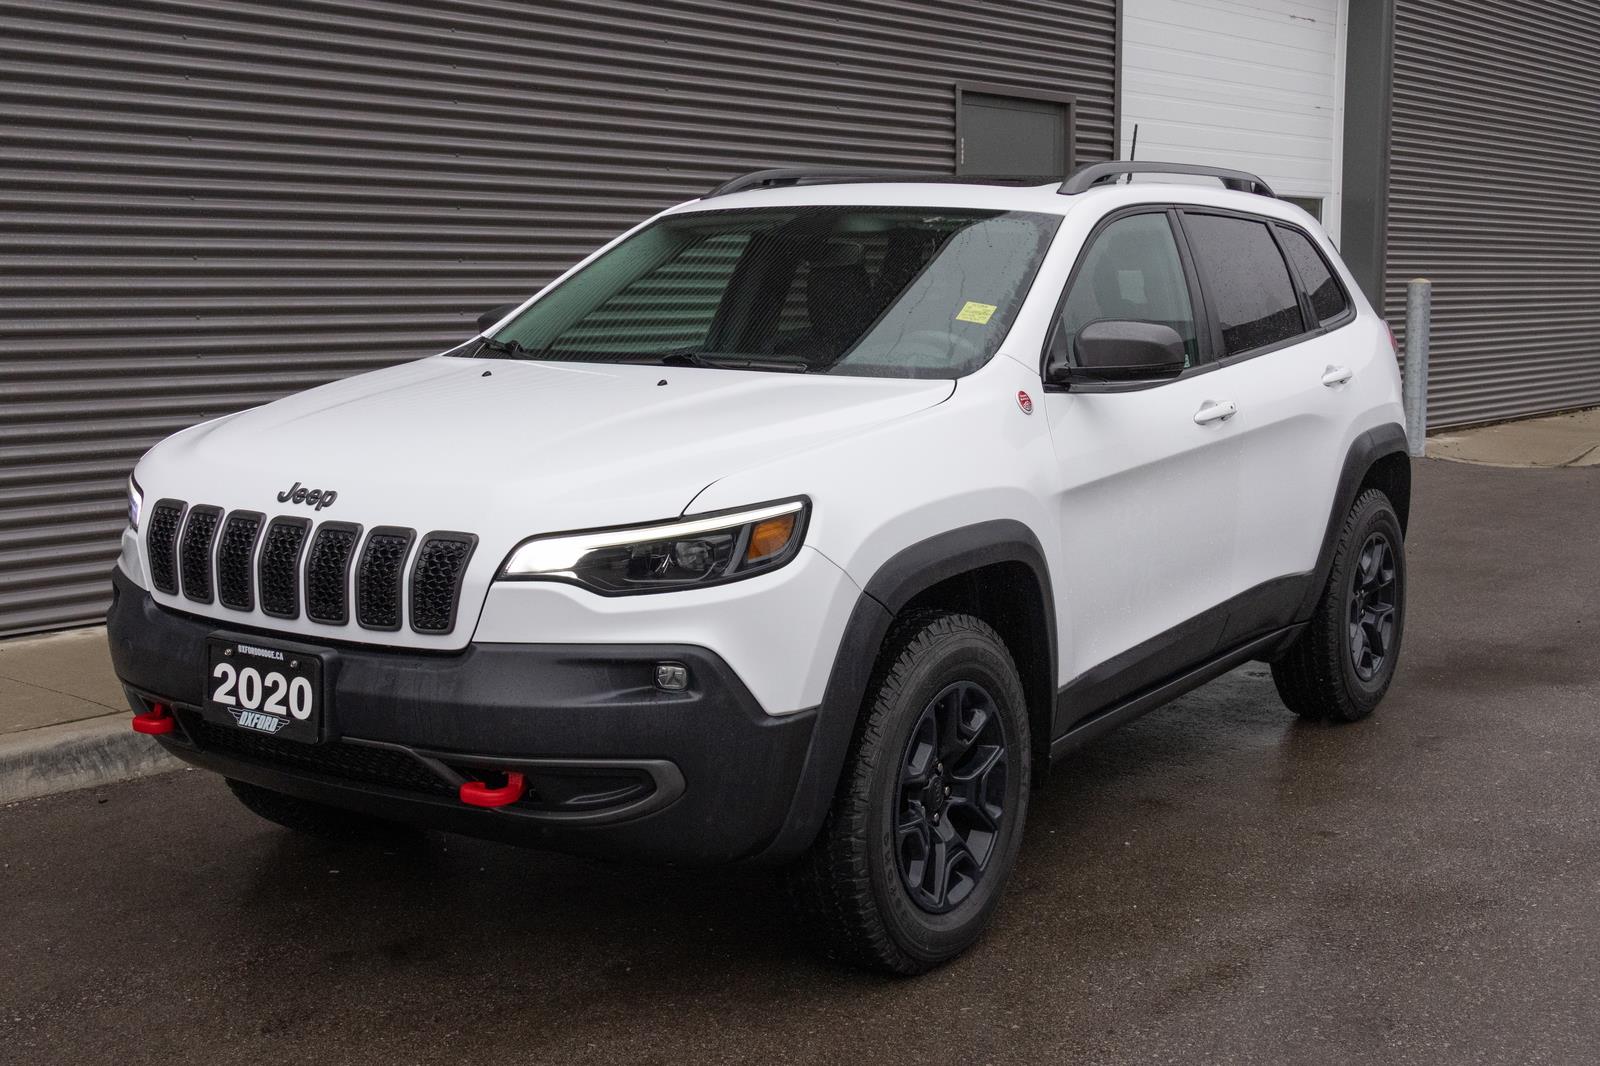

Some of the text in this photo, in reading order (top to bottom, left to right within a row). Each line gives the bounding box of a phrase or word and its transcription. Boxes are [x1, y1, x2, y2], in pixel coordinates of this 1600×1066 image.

[277, 482, 338, 511] Jeep
[212, 662, 313, 720] 2020
[239, 711, 279, 732] OXFORD
